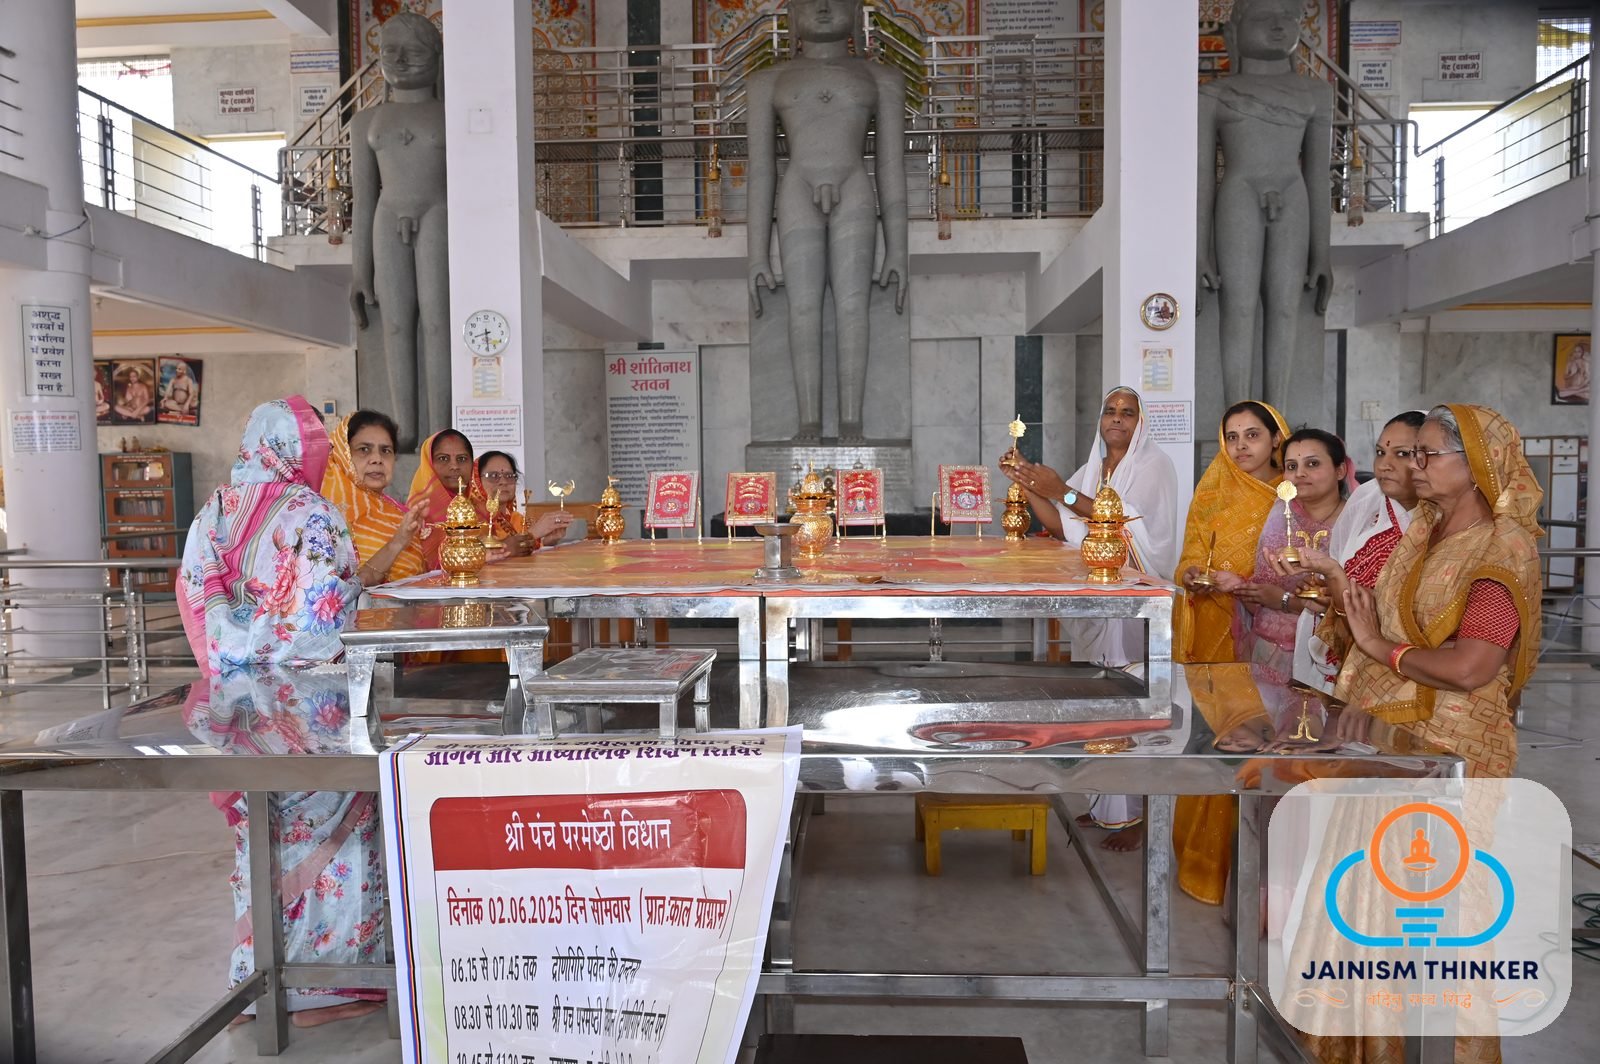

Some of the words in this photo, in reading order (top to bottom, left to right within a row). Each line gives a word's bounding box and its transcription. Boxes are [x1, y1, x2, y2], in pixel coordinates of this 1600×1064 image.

[32, 310, 61, 321] अशुद्ध
[41, 346, 64, 356] प्रवेश
[36, 359, 61, 368] करना
[608, 357, 626, 375] श्री
[630, 356, 692, 375] शांतिनाथ
[40, 371, 61, 380] सख्त
[37, 383, 53, 391] मना
[56, 383, 63, 392] है
[630, 379, 671, 392] स्तवन
[424, 750, 481, 766] आगम
[486, 748, 522, 763] और
[505, 810, 524, 852] श्री
[528, 812, 556, 851] पंच
[559, 808, 616, 852] परमेष्ठी
[620, 808, 671, 850] विधान
[447, 886, 483, 926] दिनांक
[488, 895, 563, 925] 02.06.2025
[565, 884, 588, 924] दिन
[589, 886, 632, 926] सोमवार
[451, 957, 478, 982] 06.15
[479, 947, 489, 981] से
[493, 955, 519, 980] 07.45
[522, 955, 537, 981] तक
[587, 945, 605, 982] पर्वत
[607, 946, 618, 982] की
[454, 1005, 481, 1030] 08.30
[484, 994, 493, 1030] से
[496, 1004, 522, 1030] 10.30
[525, 1005, 539, 1031] तक
[552, 994, 561, 1032] श्री
[563, 996, 574, 1033] पंच
